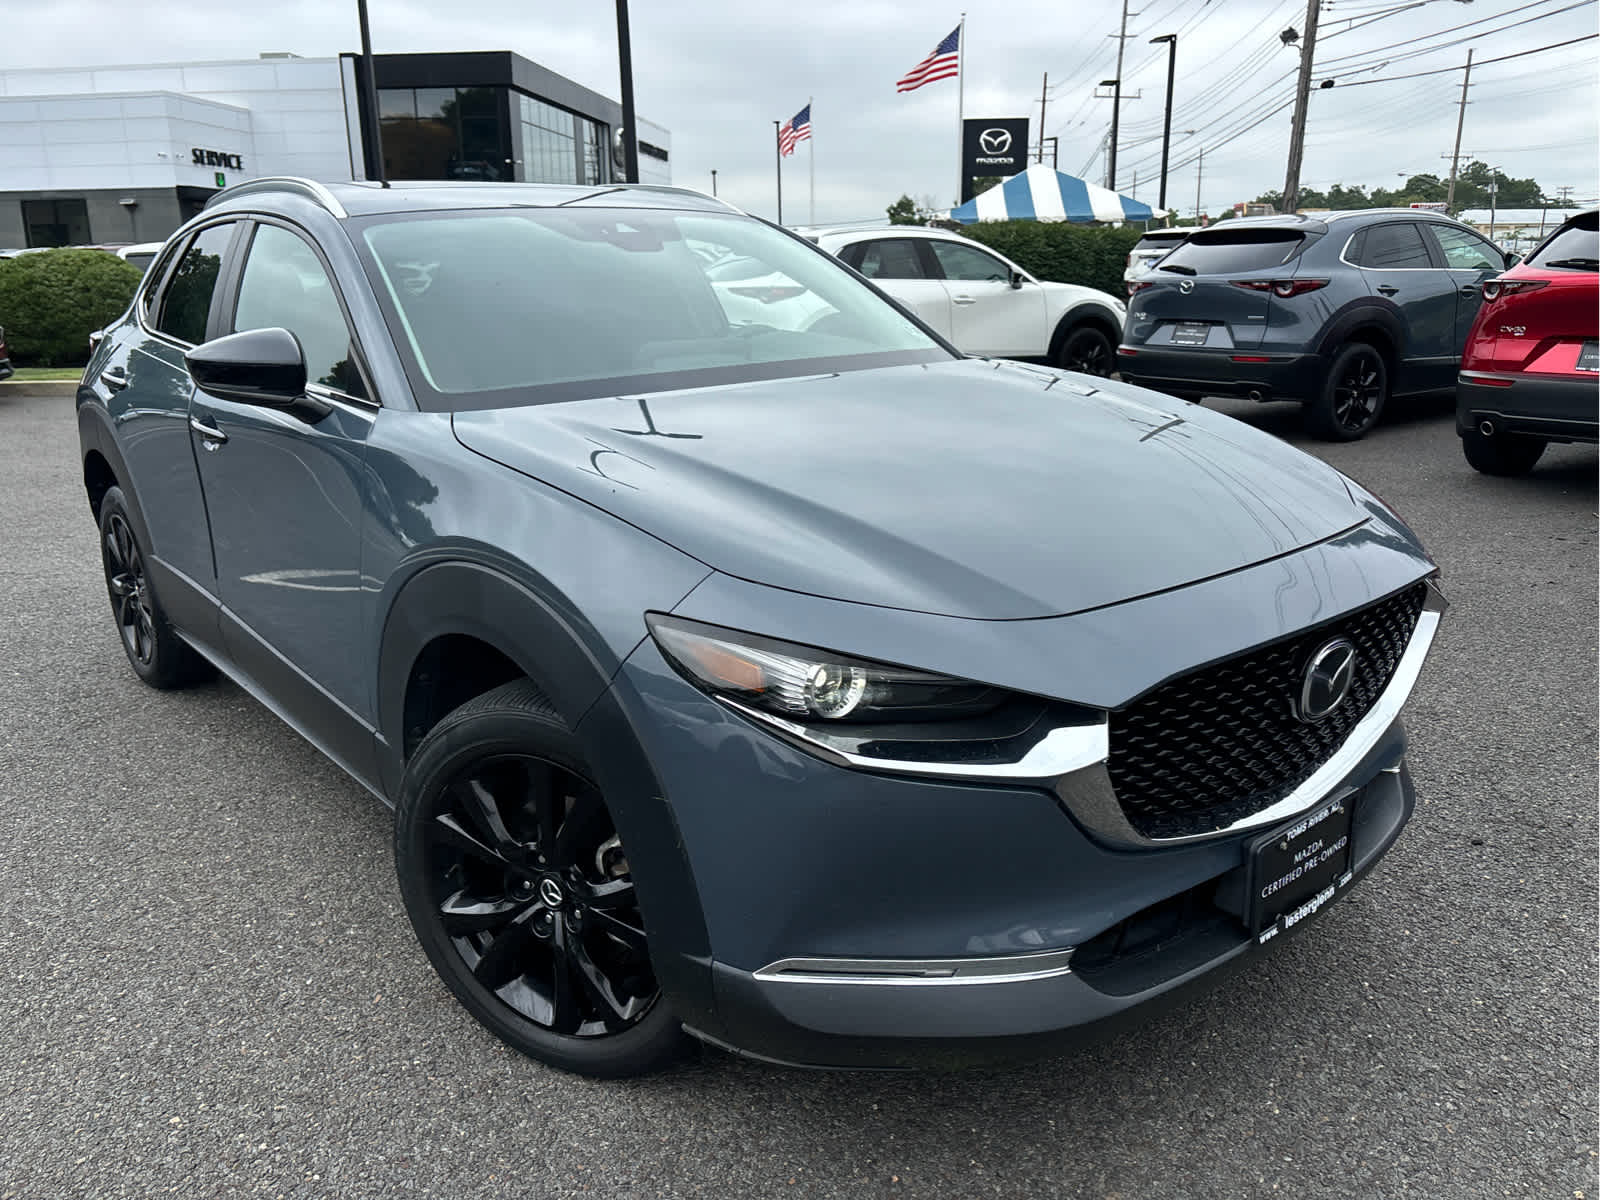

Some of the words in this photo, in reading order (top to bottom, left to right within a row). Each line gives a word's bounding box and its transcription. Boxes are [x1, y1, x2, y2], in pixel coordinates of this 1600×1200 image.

[191, 148, 245, 170] SERVICE
[1286, 821, 1308, 842] TOMS
[1293, 839, 1324, 864] MAZDA
[1261, 866, 1303, 898] CERTIFIED
[1304, 835, 1348, 873] PRE-OWNED
[1283, 885, 1336, 929] lesterglenn
